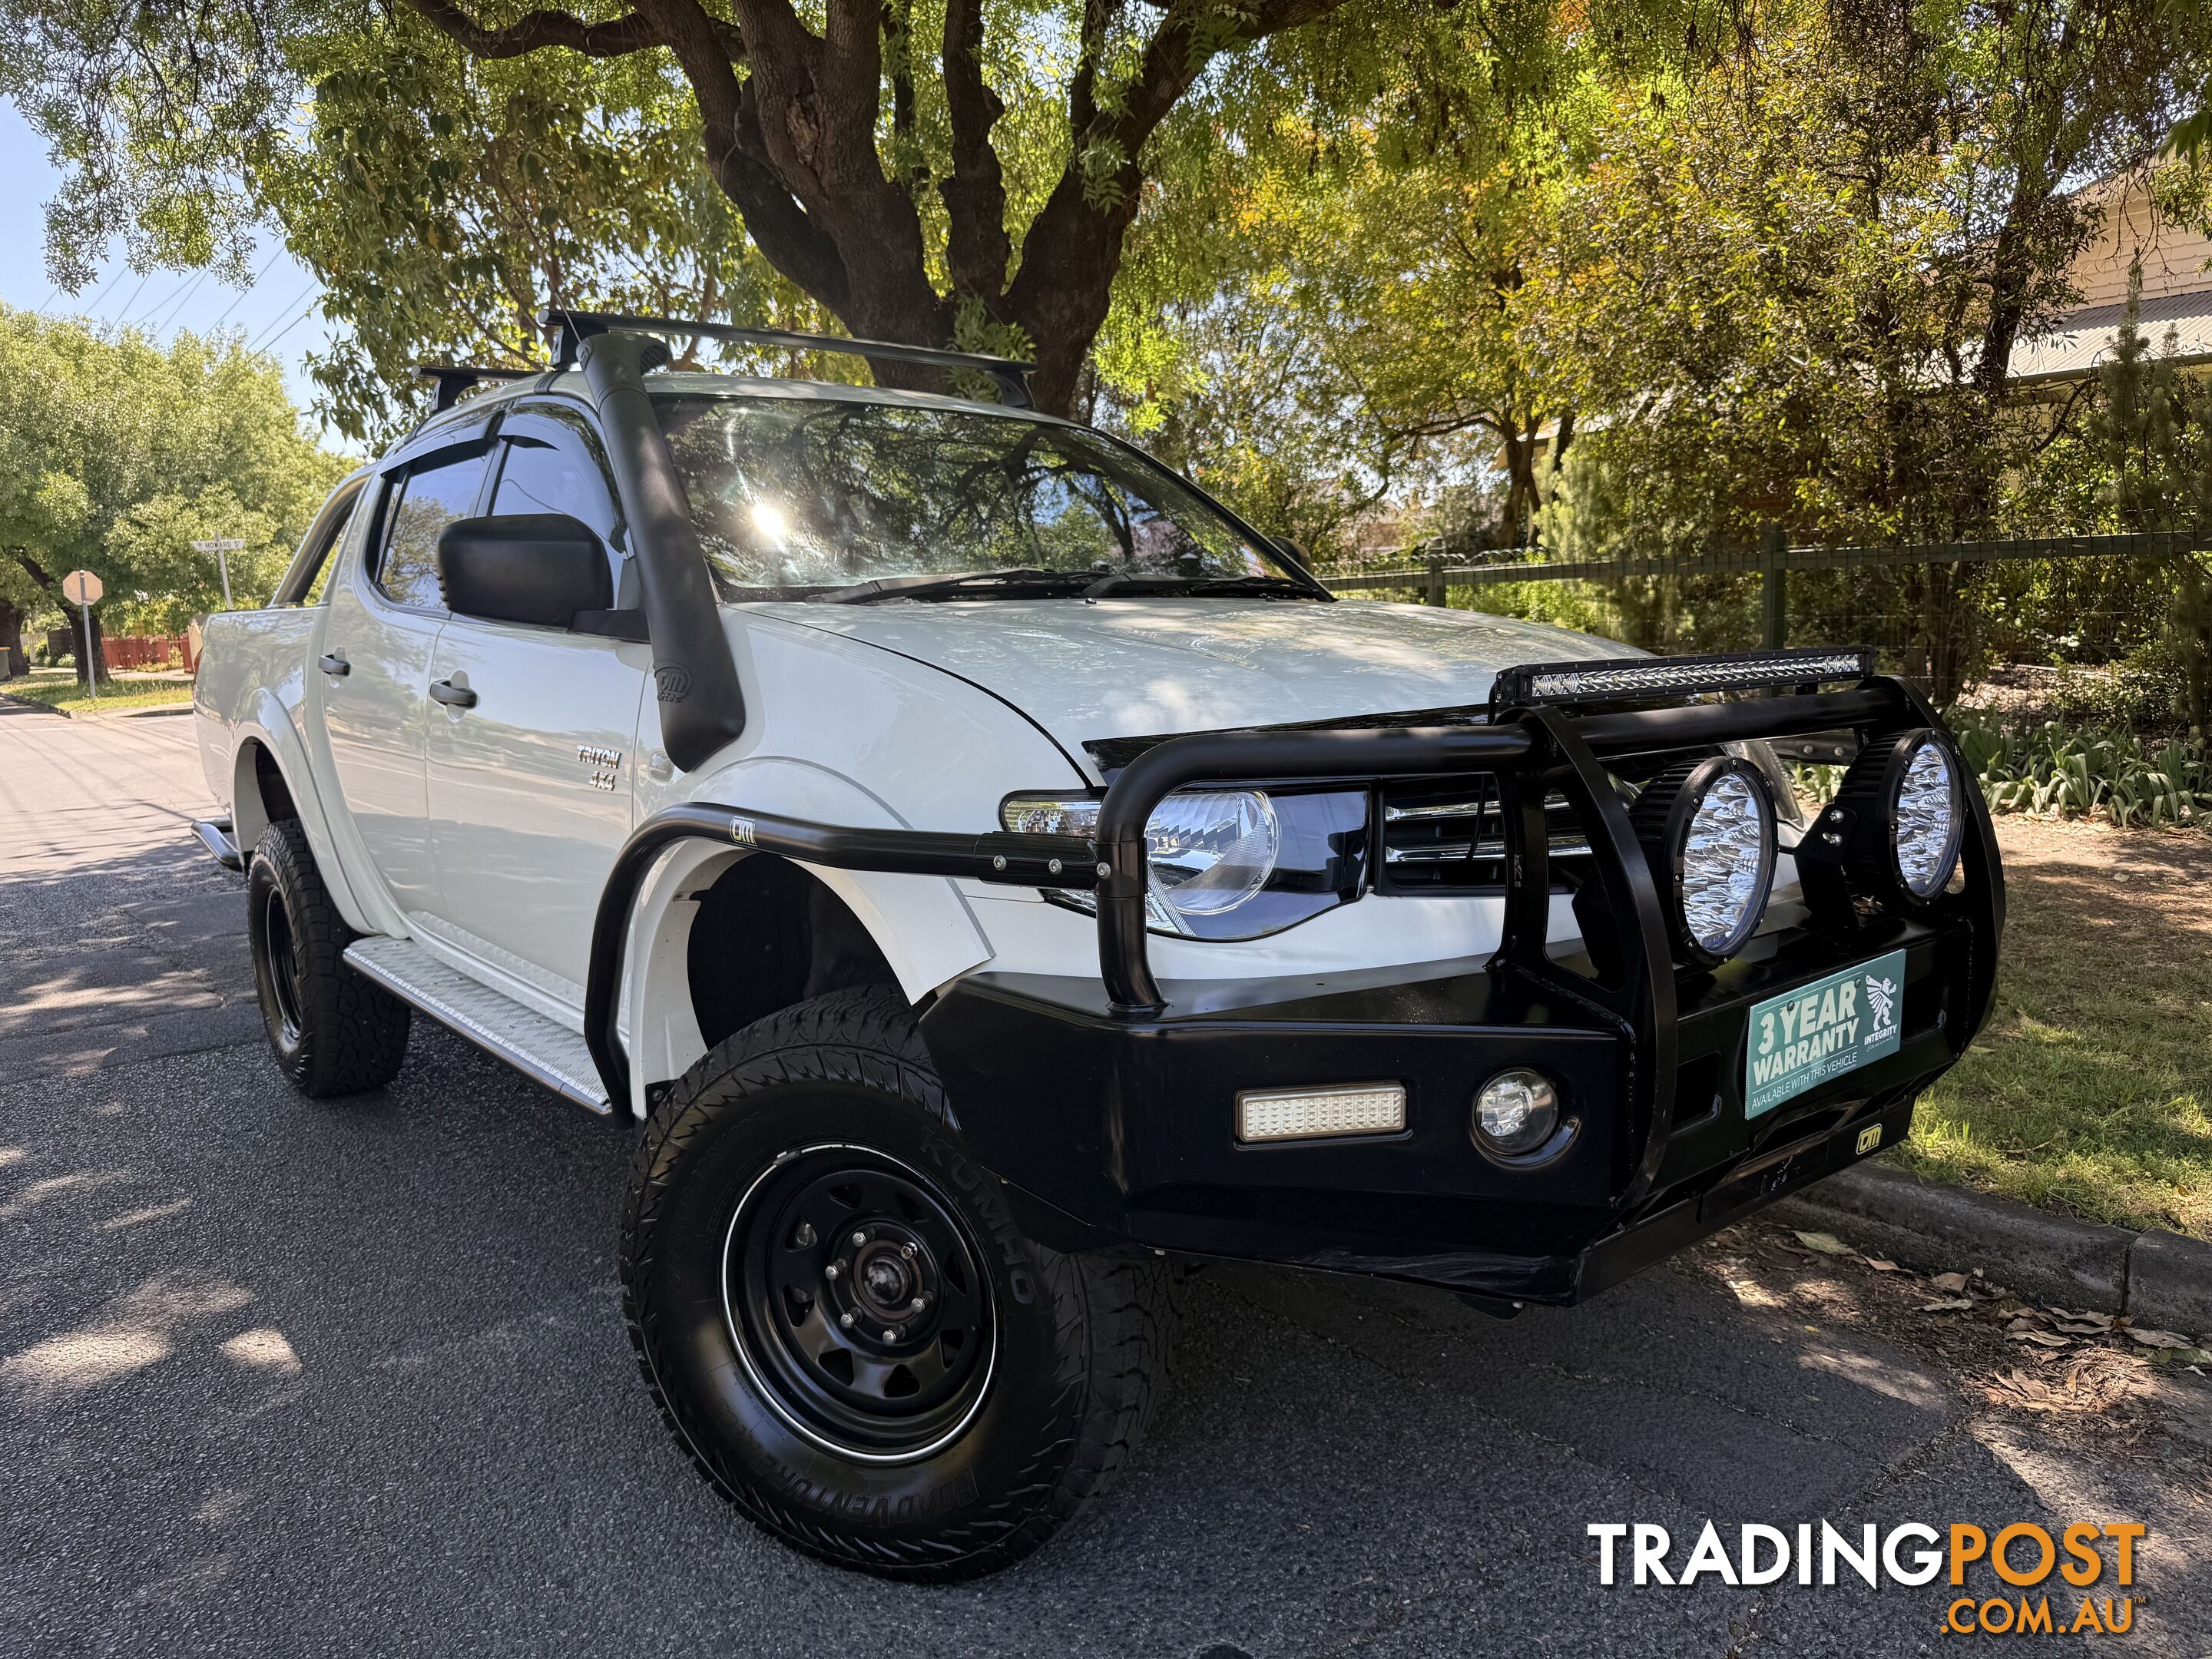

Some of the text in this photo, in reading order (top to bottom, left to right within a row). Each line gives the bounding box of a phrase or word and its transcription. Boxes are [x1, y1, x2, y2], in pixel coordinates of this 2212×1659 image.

[205, 541, 231, 549] HOWARD
[578, 744, 621, 770] TRITON
[1757, 980, 1856, 1055] 3 YEAR
[1864, 1024, 1898, 1045] INTEGRITY
[1752, 1081, 1790, 1110] AVAILABLE
[1791, 1072, 1810, 1090] WITH
[1811, 1065, 1826, 1081] THIS
[1826, 1051, 1858, 1073] VEHICLE
[1753, 1017, 1859, 1086] WARRANTY
[918, 1125, 1038, 1305] KUMHO
